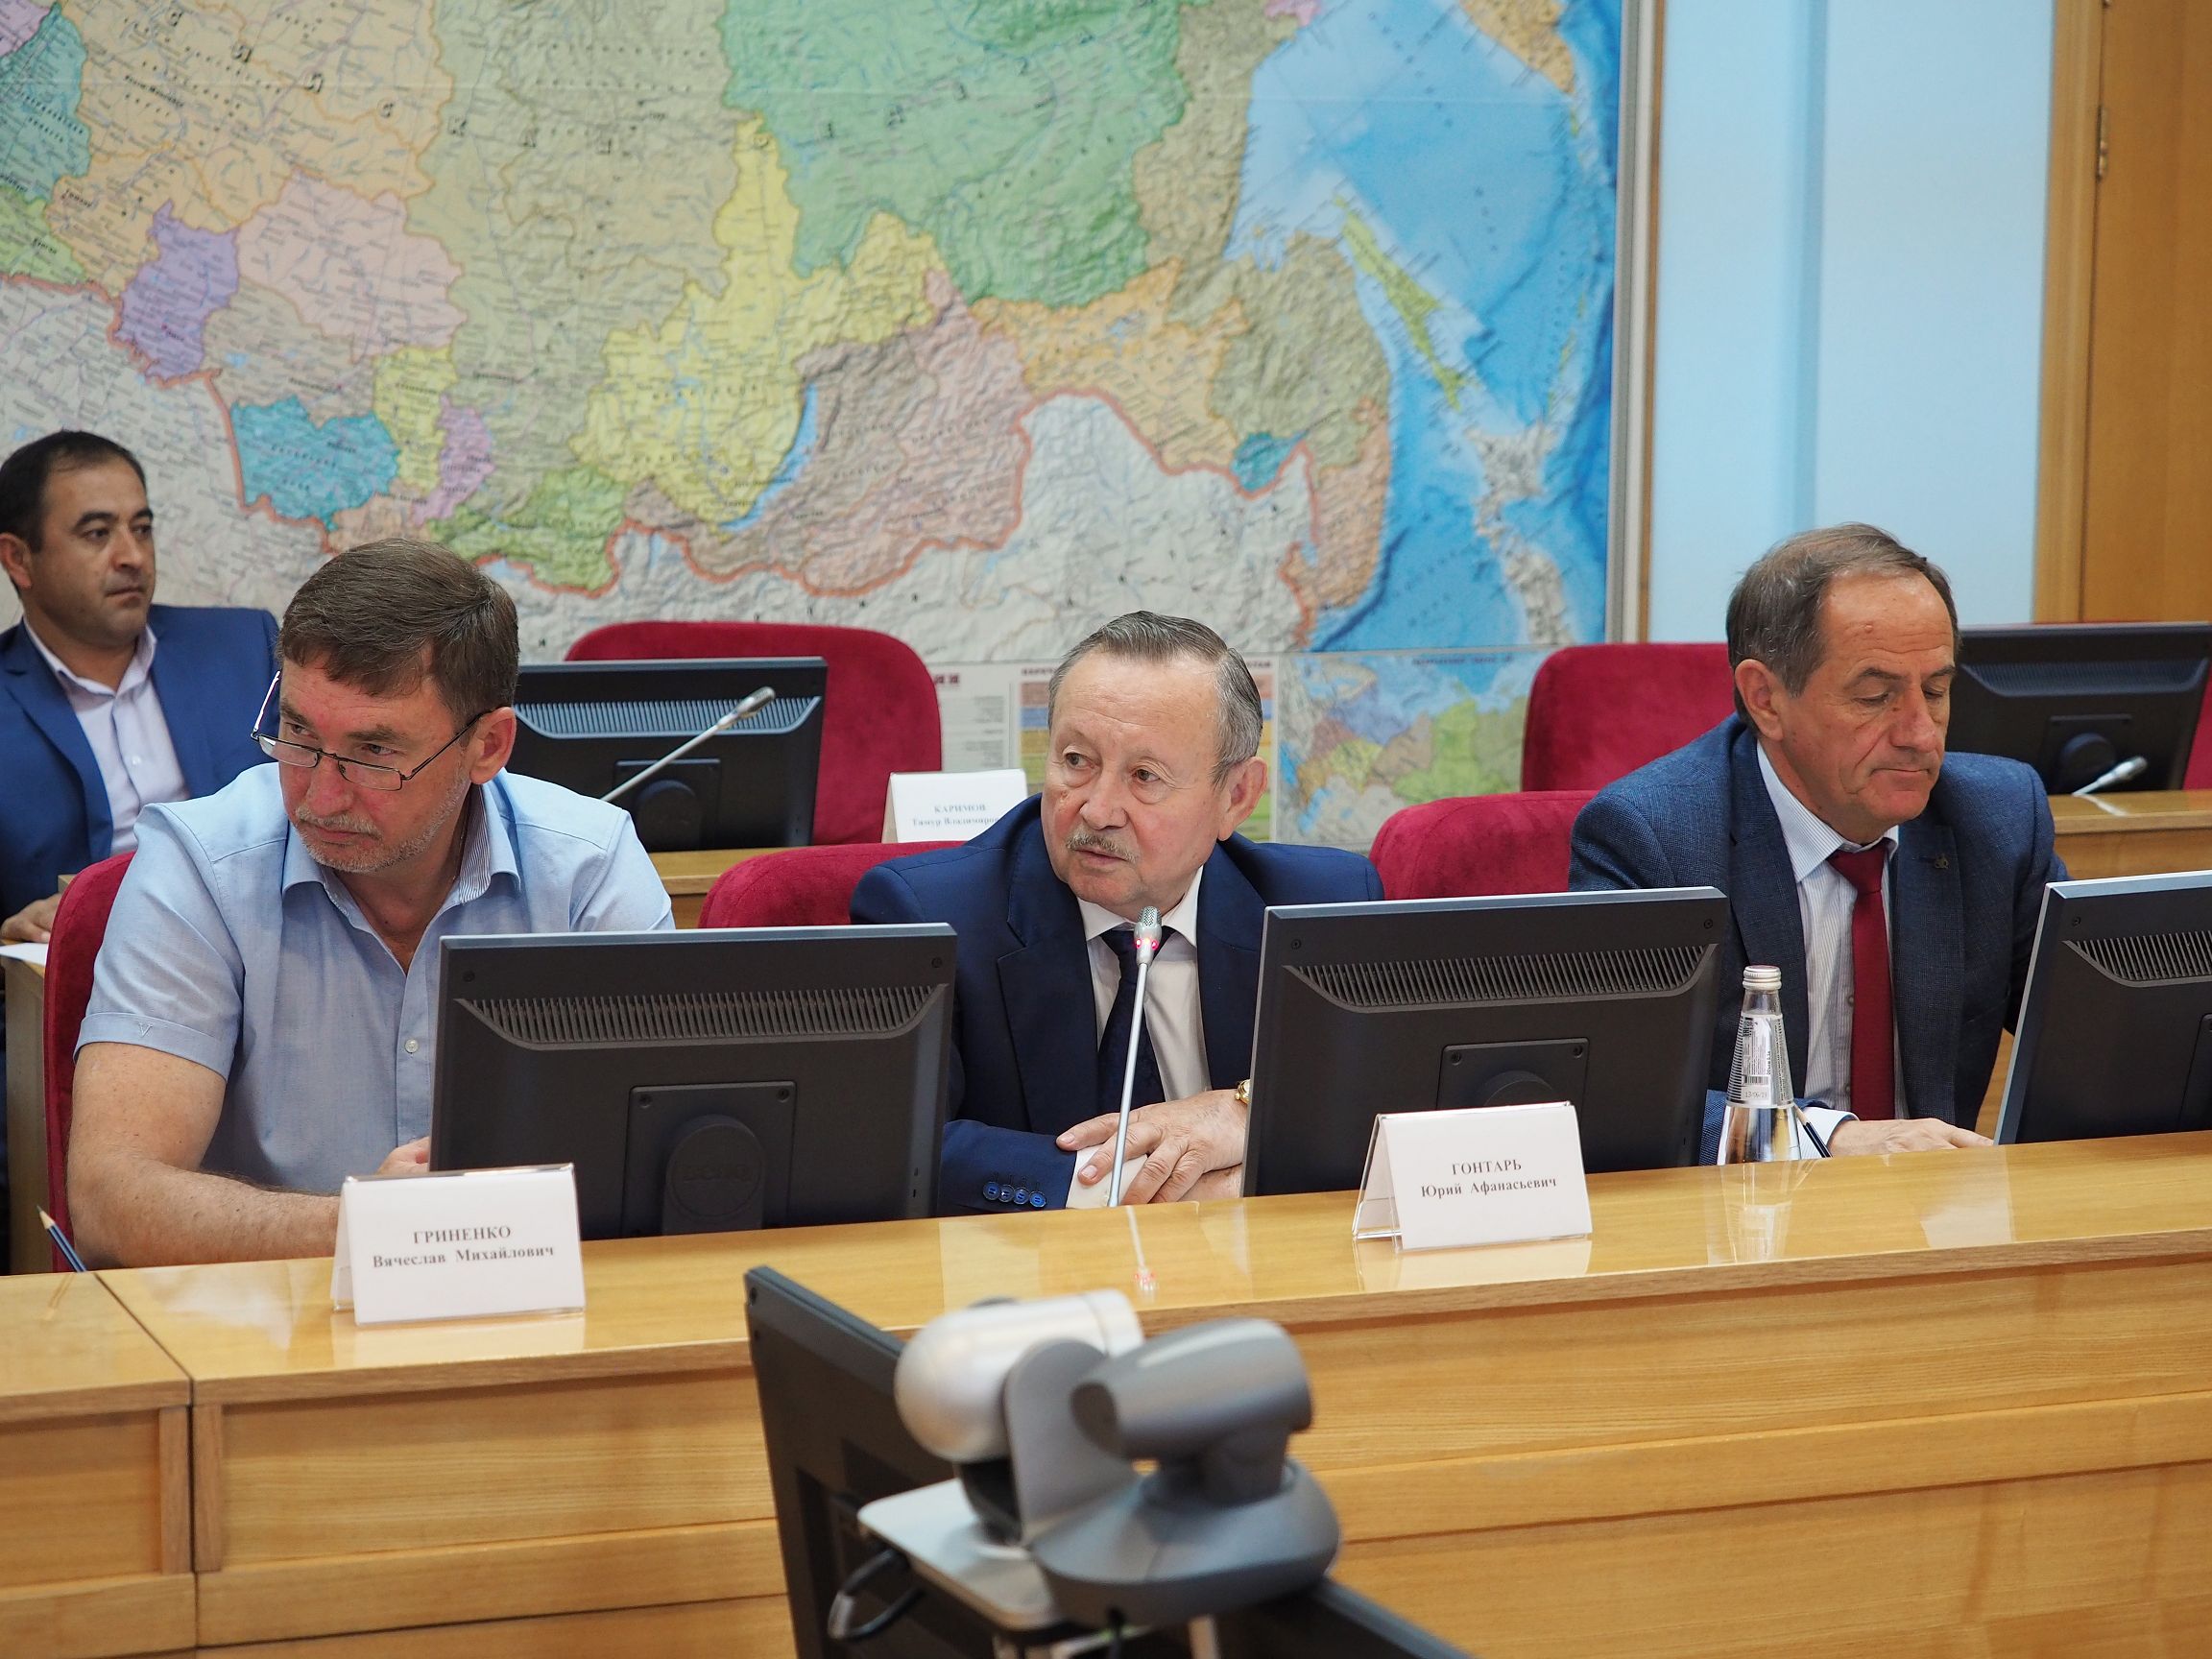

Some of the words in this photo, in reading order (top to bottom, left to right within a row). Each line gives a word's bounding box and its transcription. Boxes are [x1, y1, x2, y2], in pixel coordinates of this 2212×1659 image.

[934, 804, 986, 813] КАРИМОВ
[1452, 1158, 1523, 1176] ГОНТАРЬ
[1421, 1182, 1462, 1199] Юрий
[1470, 1177, 1557, 1195] Афанасьевич
[413, 1225, 512, 1244] ГРИНЕНКО
[373, 1254, 446, 1268] Вячеслав
[455, 1246, 555, 1262] Михайлович
